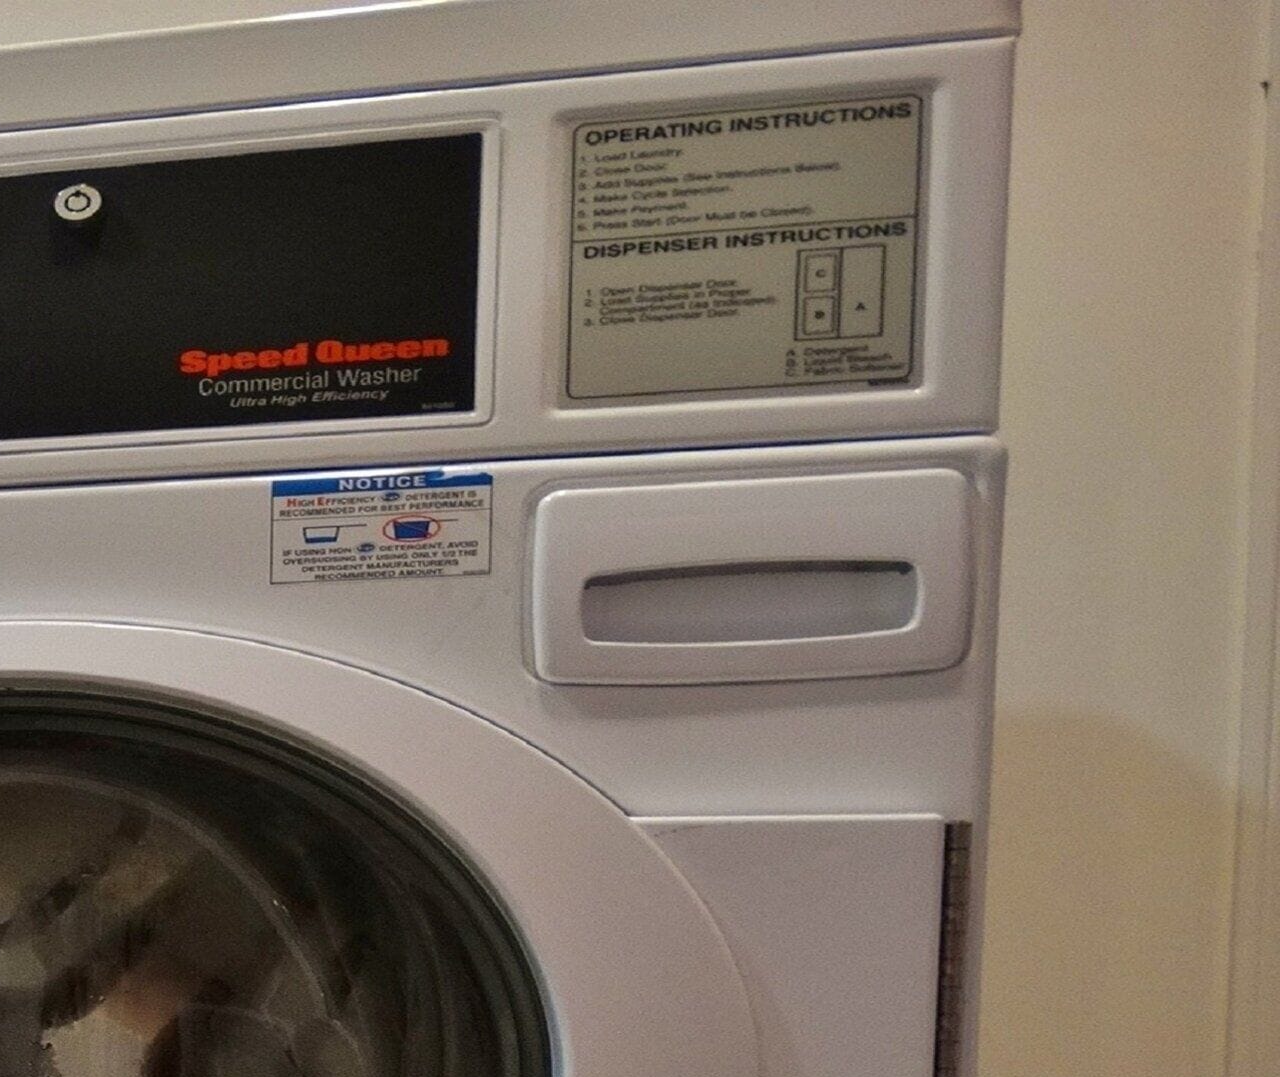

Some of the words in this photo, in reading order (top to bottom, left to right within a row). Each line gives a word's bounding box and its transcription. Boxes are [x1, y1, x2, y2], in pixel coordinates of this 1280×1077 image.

[585, 119, 722, 146] OPERATING
[730, 102, 912, 131] INSTRUCTIONS
[584, 234, 718, 260] DISPENSER
[725, 221, 908, 249] INSTRUCTIONS
[815, 269, 826, 278] C
[814, 310, 825, 319] B
[855, 302, 866, 311] A
[180, 343, 309, 377] Speed
[316, 339, 449, 363] Queen
[198, 371, 329, 396] Commercial
[337, 367, 422, 387] Washer
[230, 396, 267, 408] Ultra
[271, 393, 307, 406] High
[312, 389, 390, 403] Efficiency
[339, 475, 427, 491] NOTICE
[405, 490, 465, 501] DETERGENT
[467, 489, 477, 498] IS
[279, 505, 356, 518] RECOMMENDED
[358, 504, 378, 513] FOR
[380, 502, 406, 512] BEST
[409, 499, 484, 511] PERFORMANCE
[282, 549, 292, 557] IF
[295, 548, 326, 557] USING
[328, 546, 352, 555] NON
[447, 540, 479, 549] AVOID
[283, 555, 356, 566] OVERSUDSING
[360, 554, 373, 562] BY
[376, 551, 408, 561] USING
[411, 550, 438, 559] ONLY
[458, 548, 478, 557] THE
[301, 562, 363, 573] DETERGENT
[314, 570, 395, 581] RECOMMENDED
